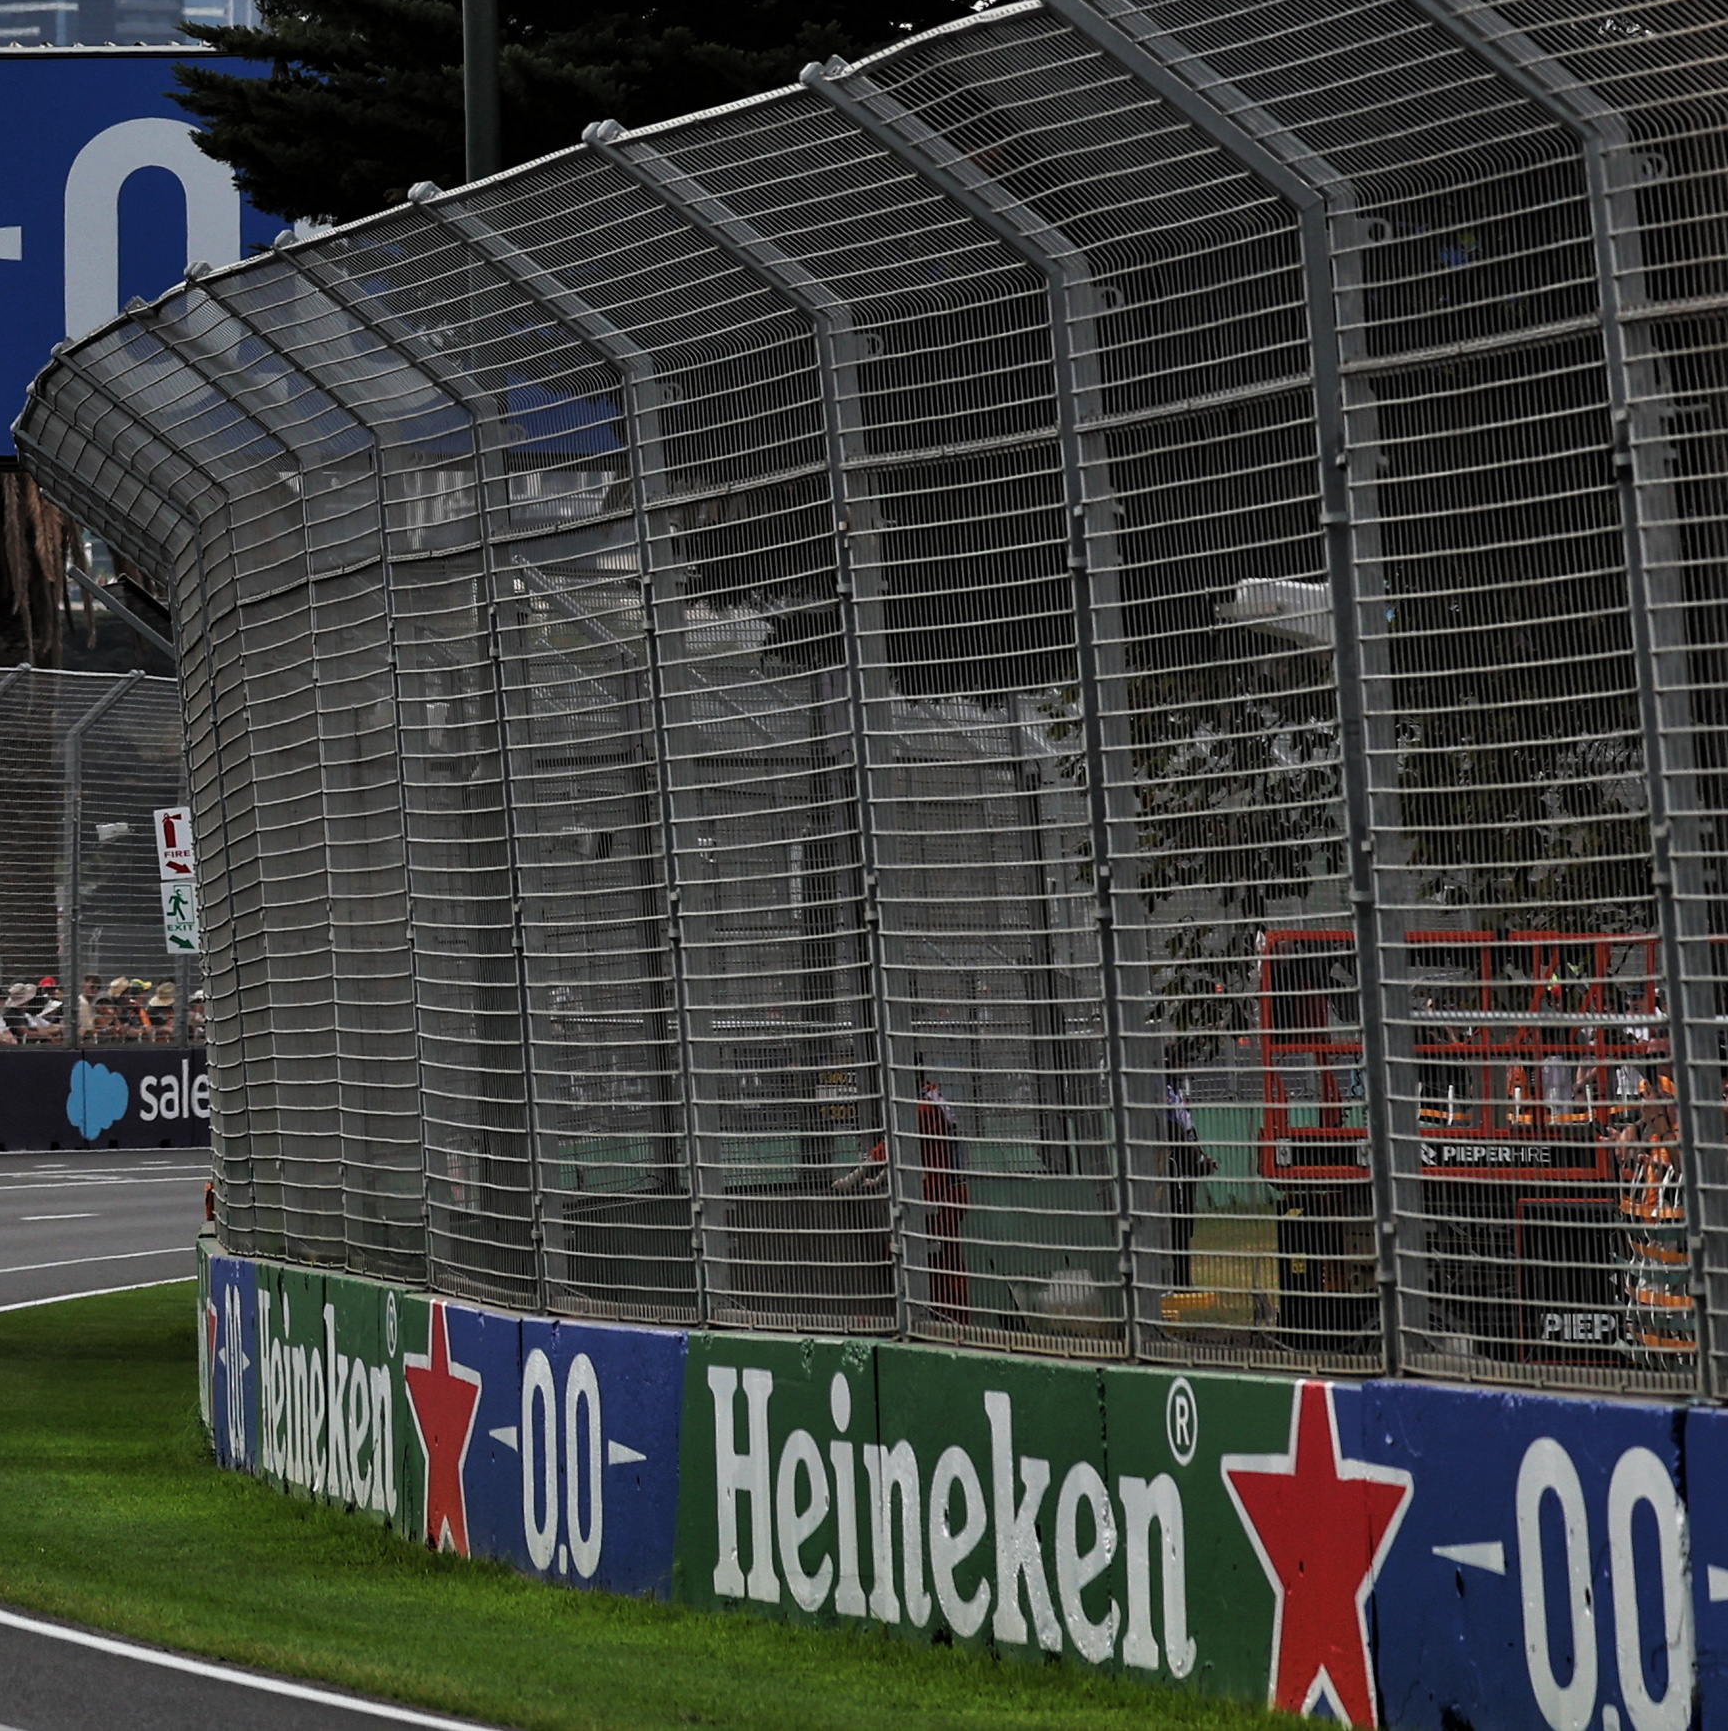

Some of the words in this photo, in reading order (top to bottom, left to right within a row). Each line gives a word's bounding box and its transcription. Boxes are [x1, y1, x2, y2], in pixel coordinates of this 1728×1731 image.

[164, 850, 191, 858] FIRE
[167, 924, 193, 932] EXIT
[257, 1289, 398, 1517] Heineken
[522, 1349, 603, 1578] 0.0
[707, 1365, 1198, 1679] Heineken
[1516, 1437, 1696, 1731] 0.0
